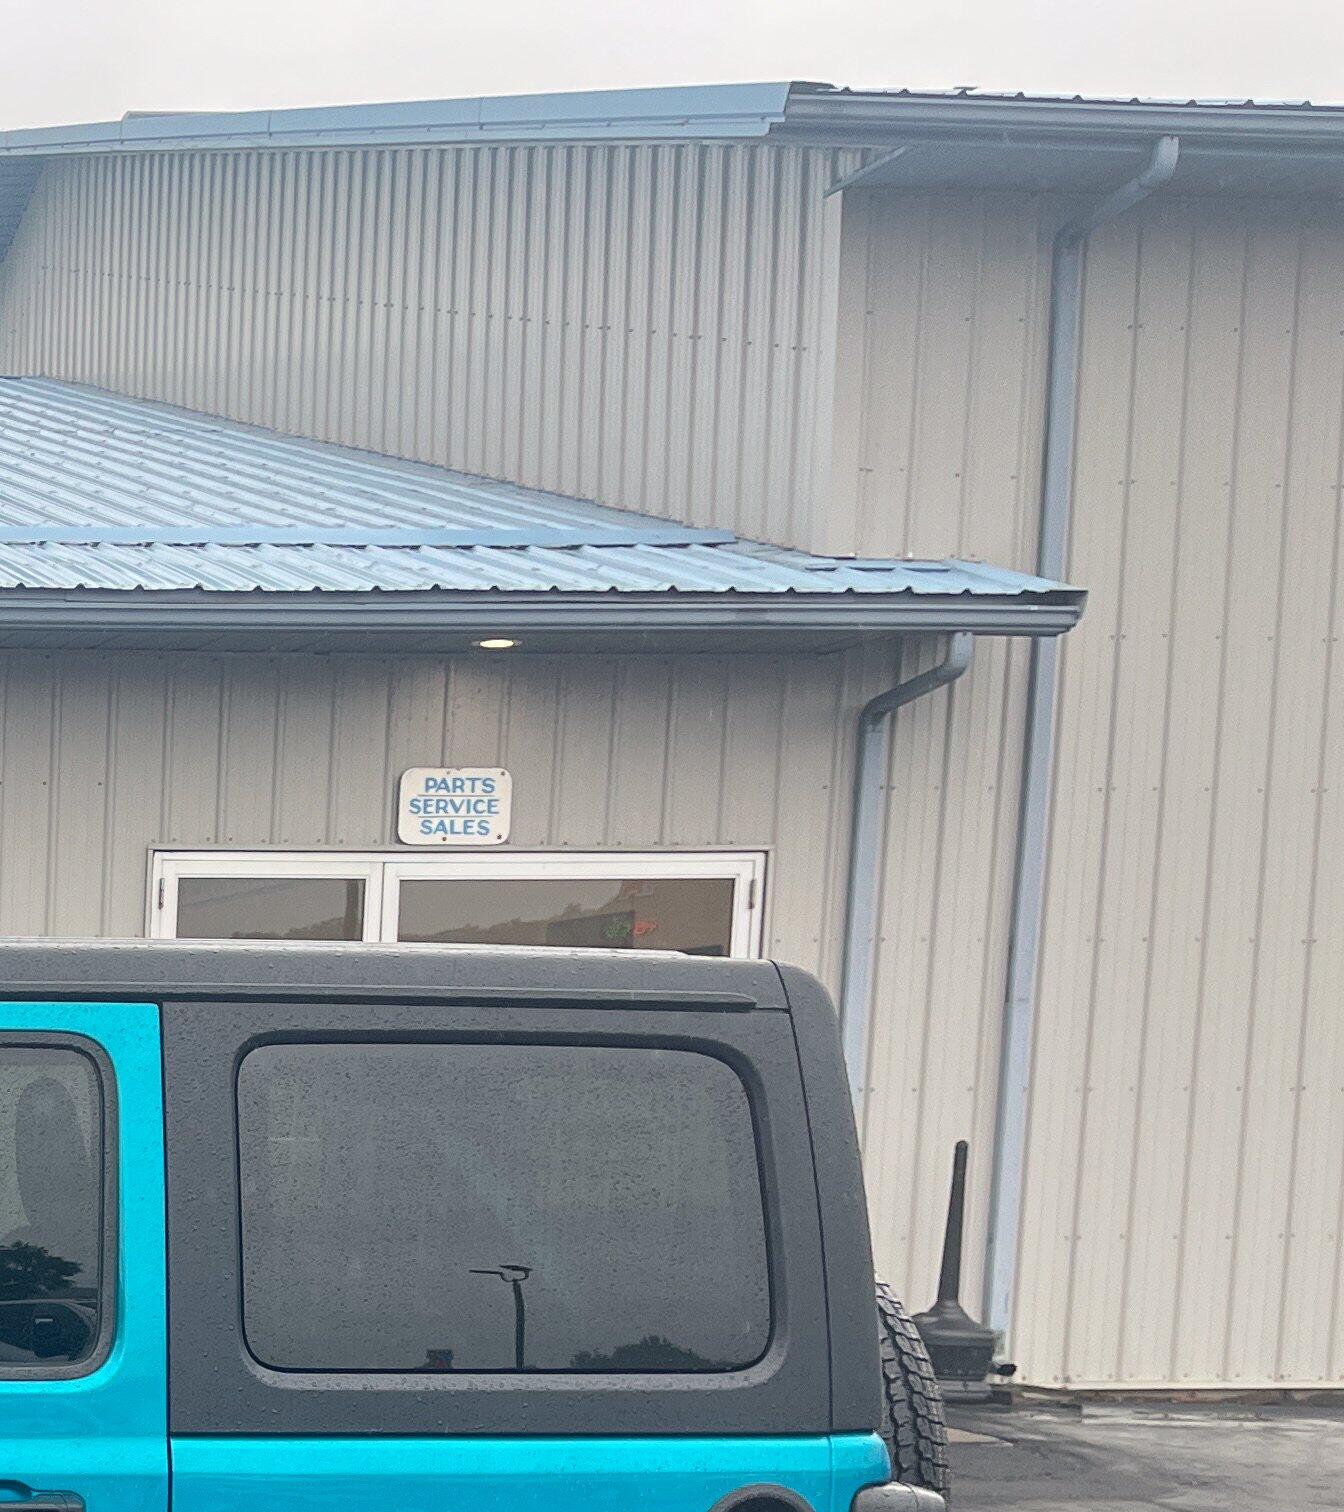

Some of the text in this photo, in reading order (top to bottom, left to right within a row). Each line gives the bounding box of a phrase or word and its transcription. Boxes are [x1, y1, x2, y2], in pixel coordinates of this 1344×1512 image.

[425, 777, 496, 794] PARTS
[408, 798, 501, 815] SERVICE
[419, 819, 491, 836] SALES
